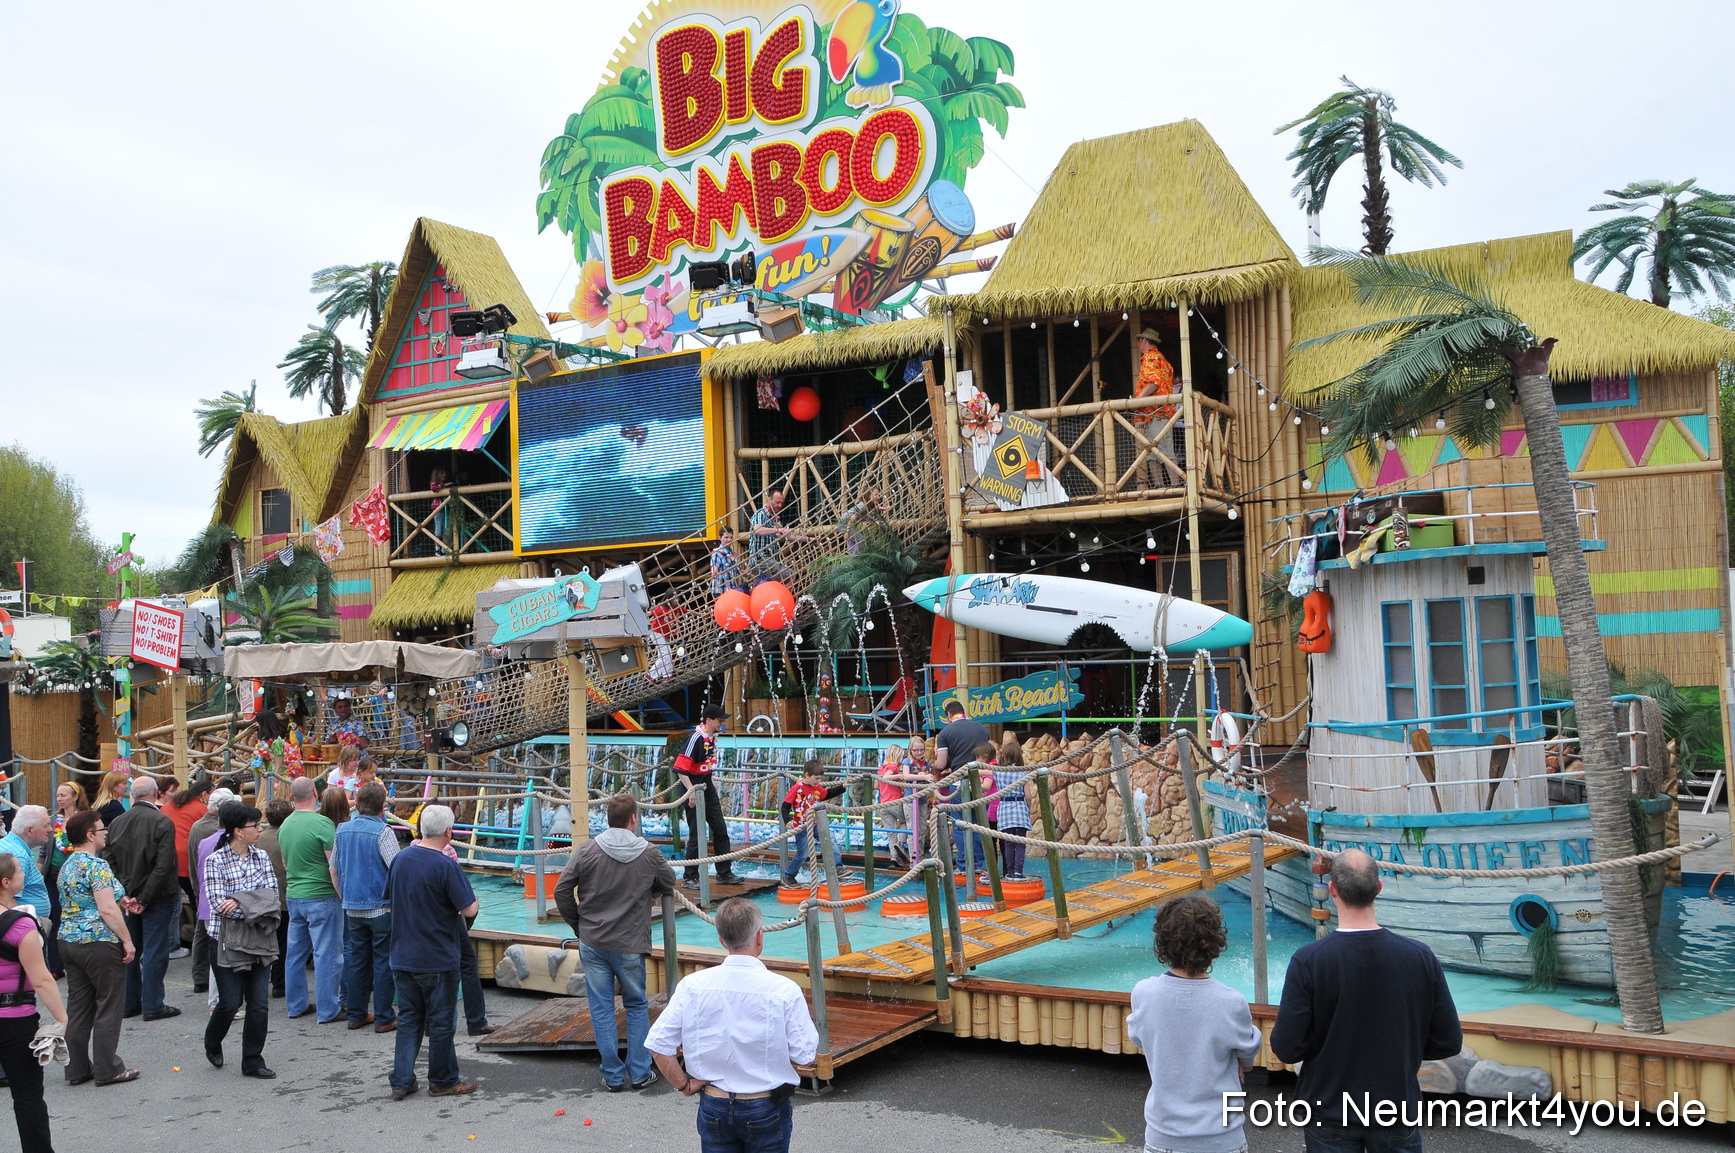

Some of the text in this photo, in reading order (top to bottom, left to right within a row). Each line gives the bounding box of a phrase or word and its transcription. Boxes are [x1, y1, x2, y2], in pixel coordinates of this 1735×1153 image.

[655, 16, 809, 156] BIG
[604, 107, 925, 285] BAMBOO
[754, 235, 831, 293] fun!
[1006, 415, 1043, 439] STORM
[979, 475, 1023, 502] WARNING
[508, 589, 557, 617] CUBAN
[137, 611, 177, 630] NO! SHOES
[510, 604, 559, 632] CIGARS
[135, 637, 177, 659] NO! PROBLEM
[136, 624, 178, 644] NO! T-SHIRT
[1005, 680, 1069, 712] Beach
